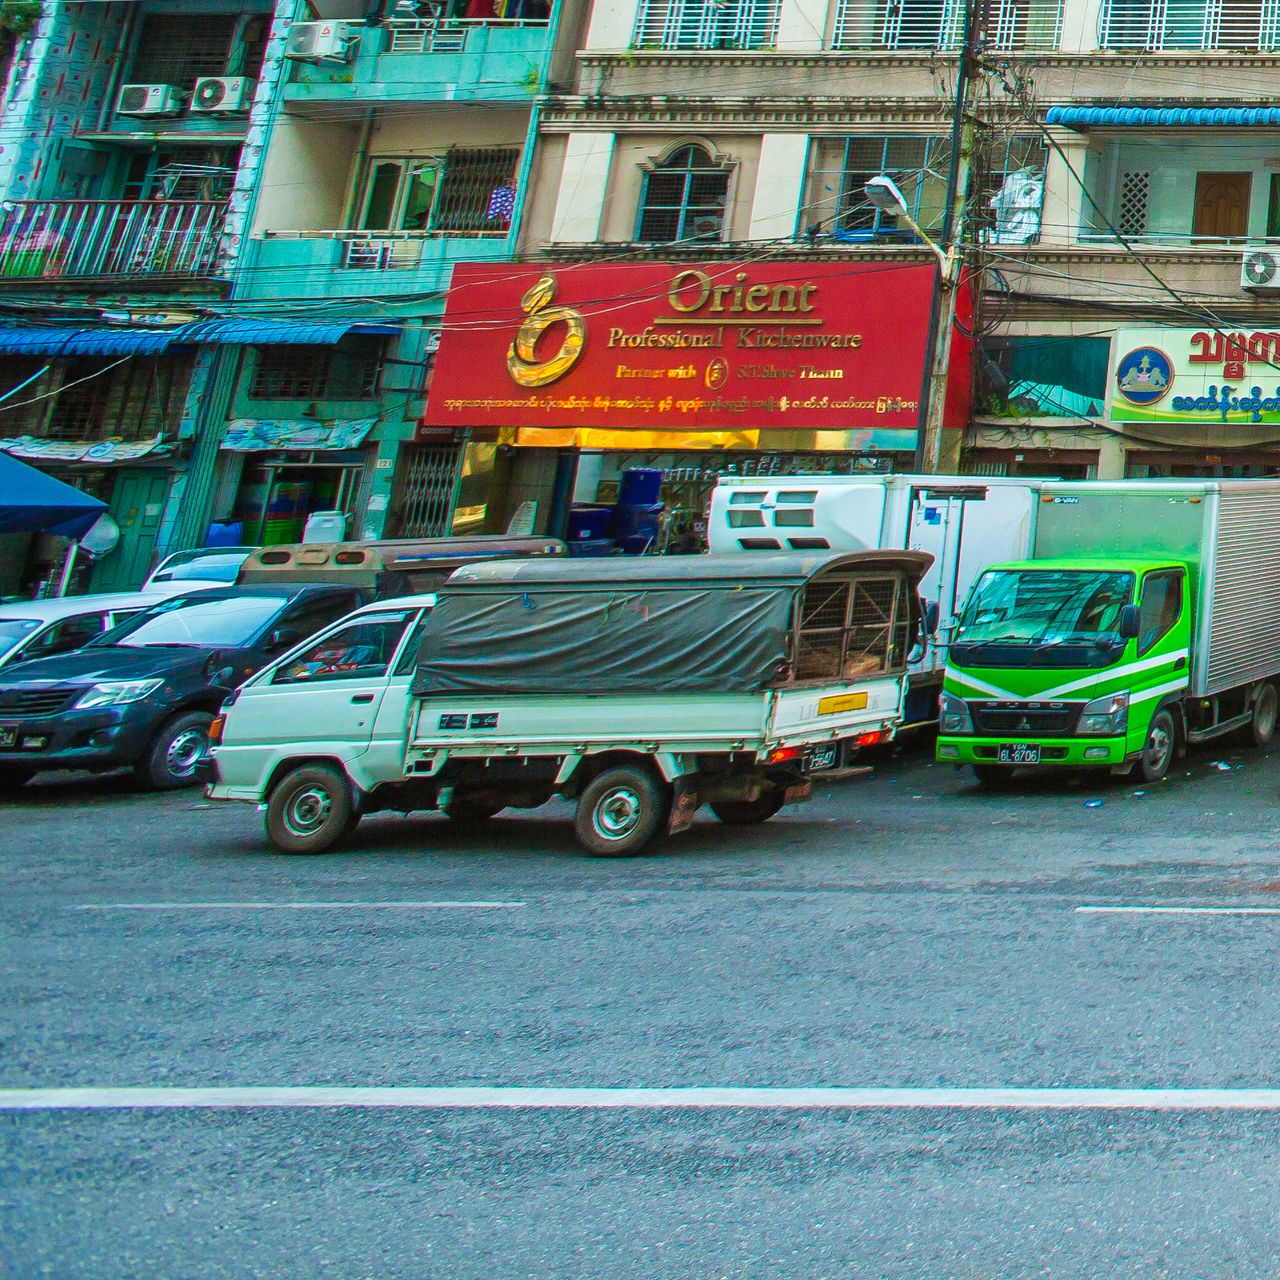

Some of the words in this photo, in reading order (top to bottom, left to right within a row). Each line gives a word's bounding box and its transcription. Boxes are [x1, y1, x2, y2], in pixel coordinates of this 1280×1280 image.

[668, 269, 818, 314] Orient
[607, 327, 724, 349] Professional
[735, 328, 863, 349] Kitchenware
[616, 365, 665, 379] Partner
[668, 364, 697, 379] with
